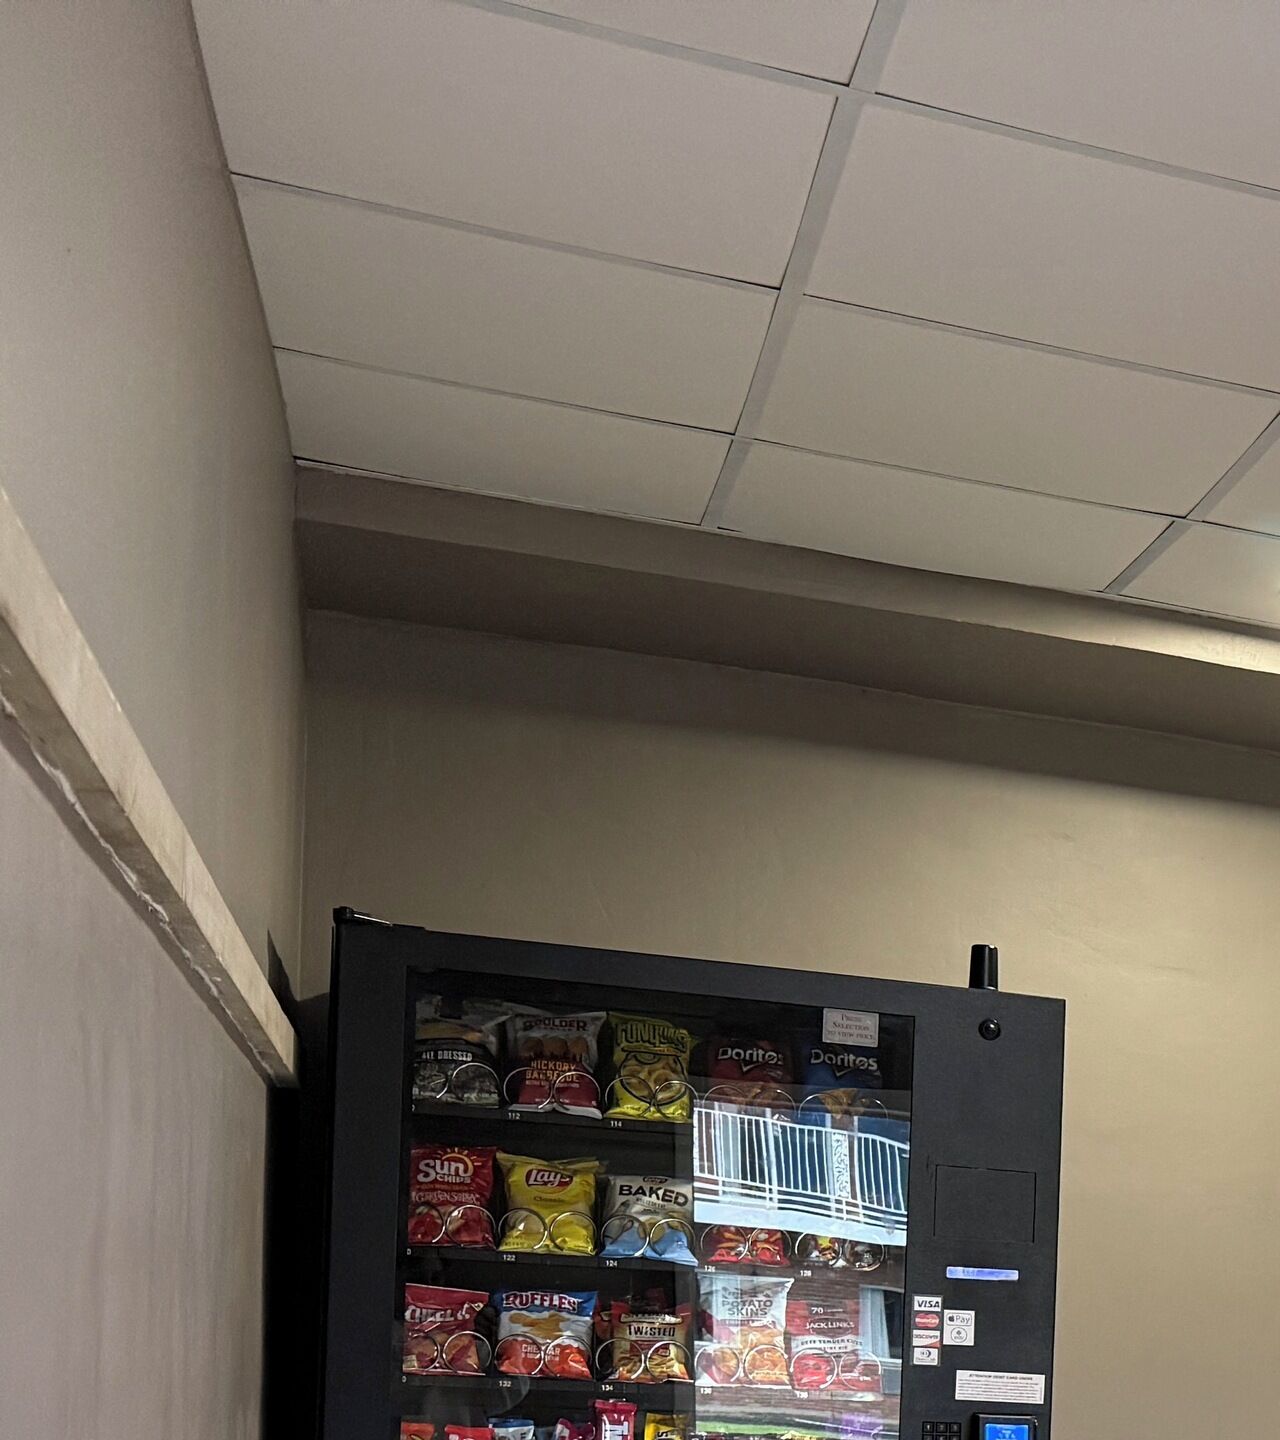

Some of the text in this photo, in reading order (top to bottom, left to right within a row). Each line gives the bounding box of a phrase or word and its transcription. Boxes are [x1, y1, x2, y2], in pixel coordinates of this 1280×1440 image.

[437, 1050, 473, 1062] DRESSED
[810, 1048, 878, 1071] Doritos
[530, 1059, 576, 1071] HICKORY
[507, 1112, 521, 1120] 112
[610, 1120, 623, 1128] 114
[416, 1158, 466, 1183] Sun
[436, 1173, 472, 1184] CHIPS
[618, 1184, 690, 1208] BAKED
[503, 1291, 578, 1313] RUFFLES
[722, 1299, 773, 1309] POTATO
[917, 1300, 940, 1308] VISA
[727, 1307, 768, 1317] SKINS
[955, 1315, 971, 1324] Pay
[521, 1343, 560, 1356] CHEAR
[499, 1380, 512, 1388] 132
